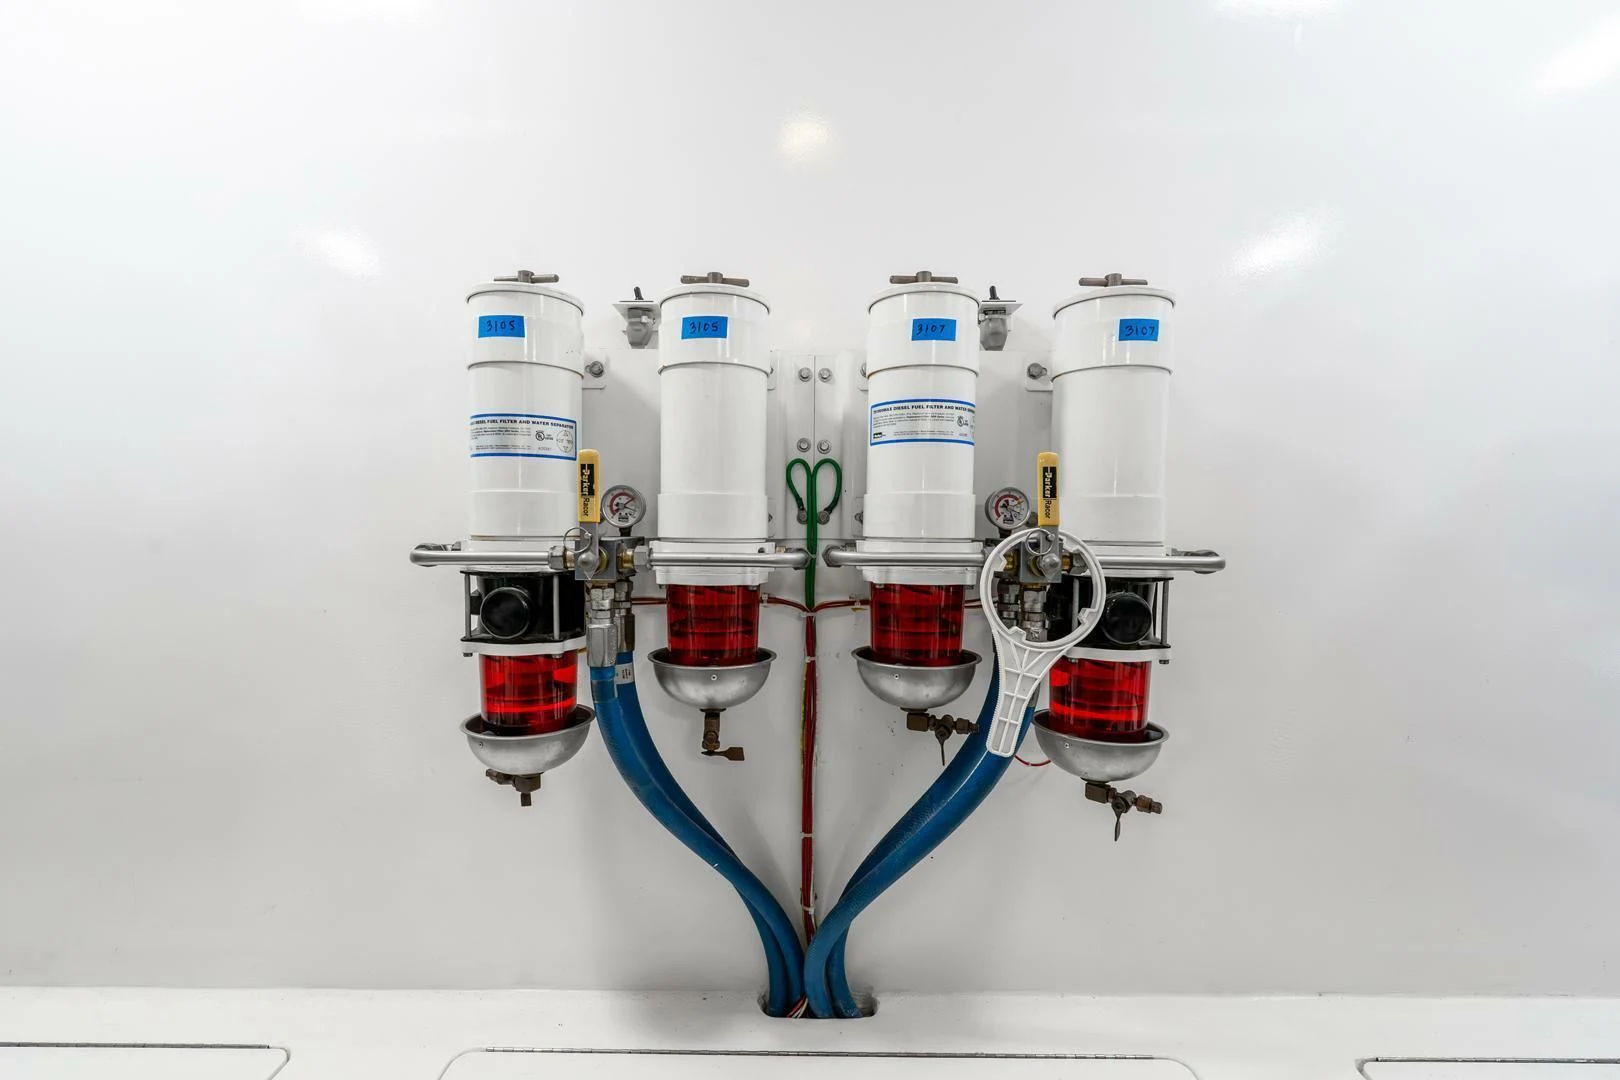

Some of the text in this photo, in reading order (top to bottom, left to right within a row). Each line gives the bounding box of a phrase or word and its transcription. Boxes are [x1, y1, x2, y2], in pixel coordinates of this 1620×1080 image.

[486, 319, 516, 332] 3105
[690, 321, 719, 335] 3105
[916, 323, 945, 336] 3107
[1124, 324, 1156, 337] 3107
[582, 464, 591, 517] Parker Racor
[1044, 467, 1053, 519] Parker Racor
